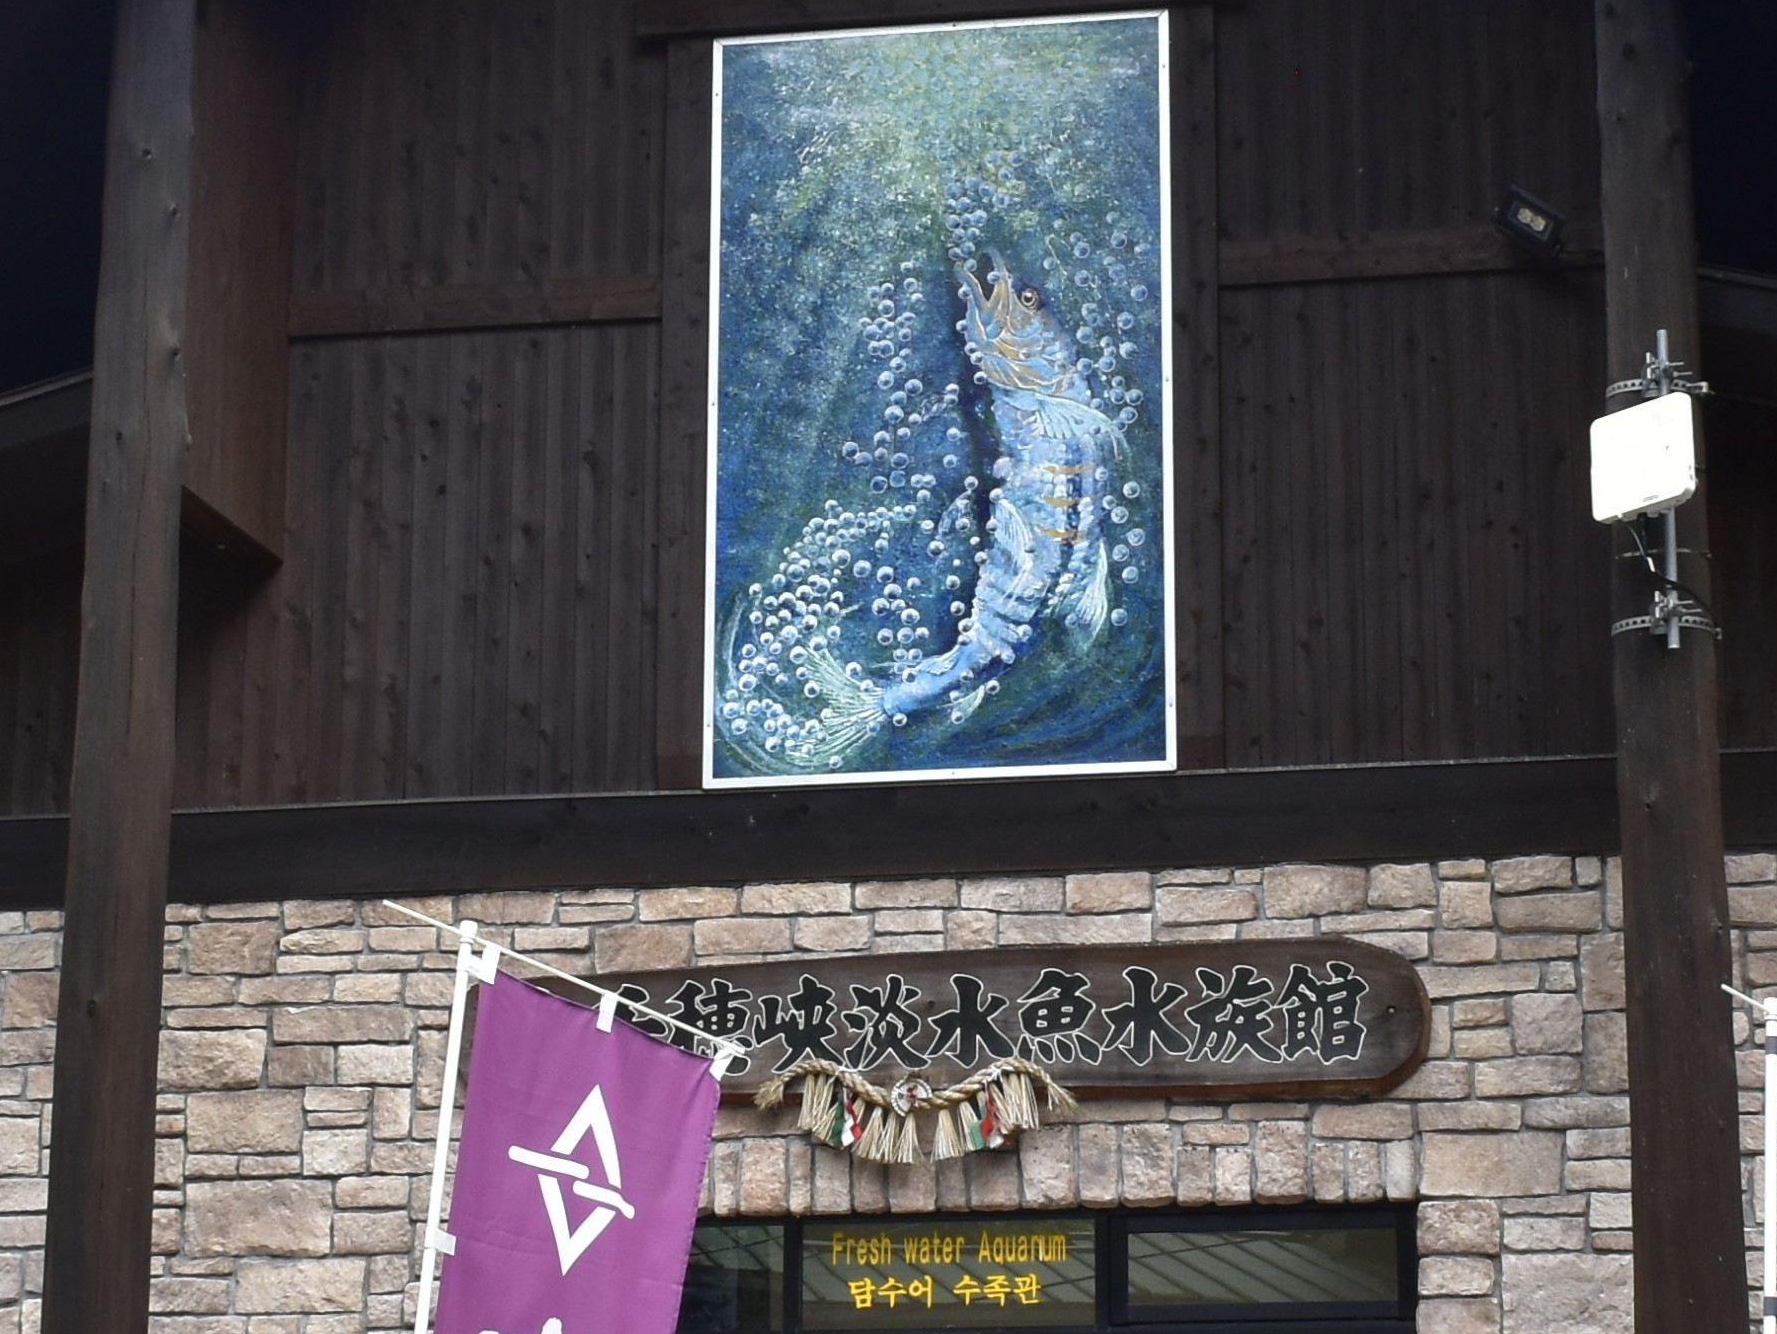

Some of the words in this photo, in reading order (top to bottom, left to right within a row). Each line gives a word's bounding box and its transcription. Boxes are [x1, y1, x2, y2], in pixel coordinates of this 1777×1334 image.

[832, 1232, 892, 1265] Fresh
[904, 1231, 965, 1264] water
[978, 1230, 1066, 1264] Aquarium
[848, 1275, 933, 1309] 담수어
[953, 1273, 1042, 1308] 수족관
